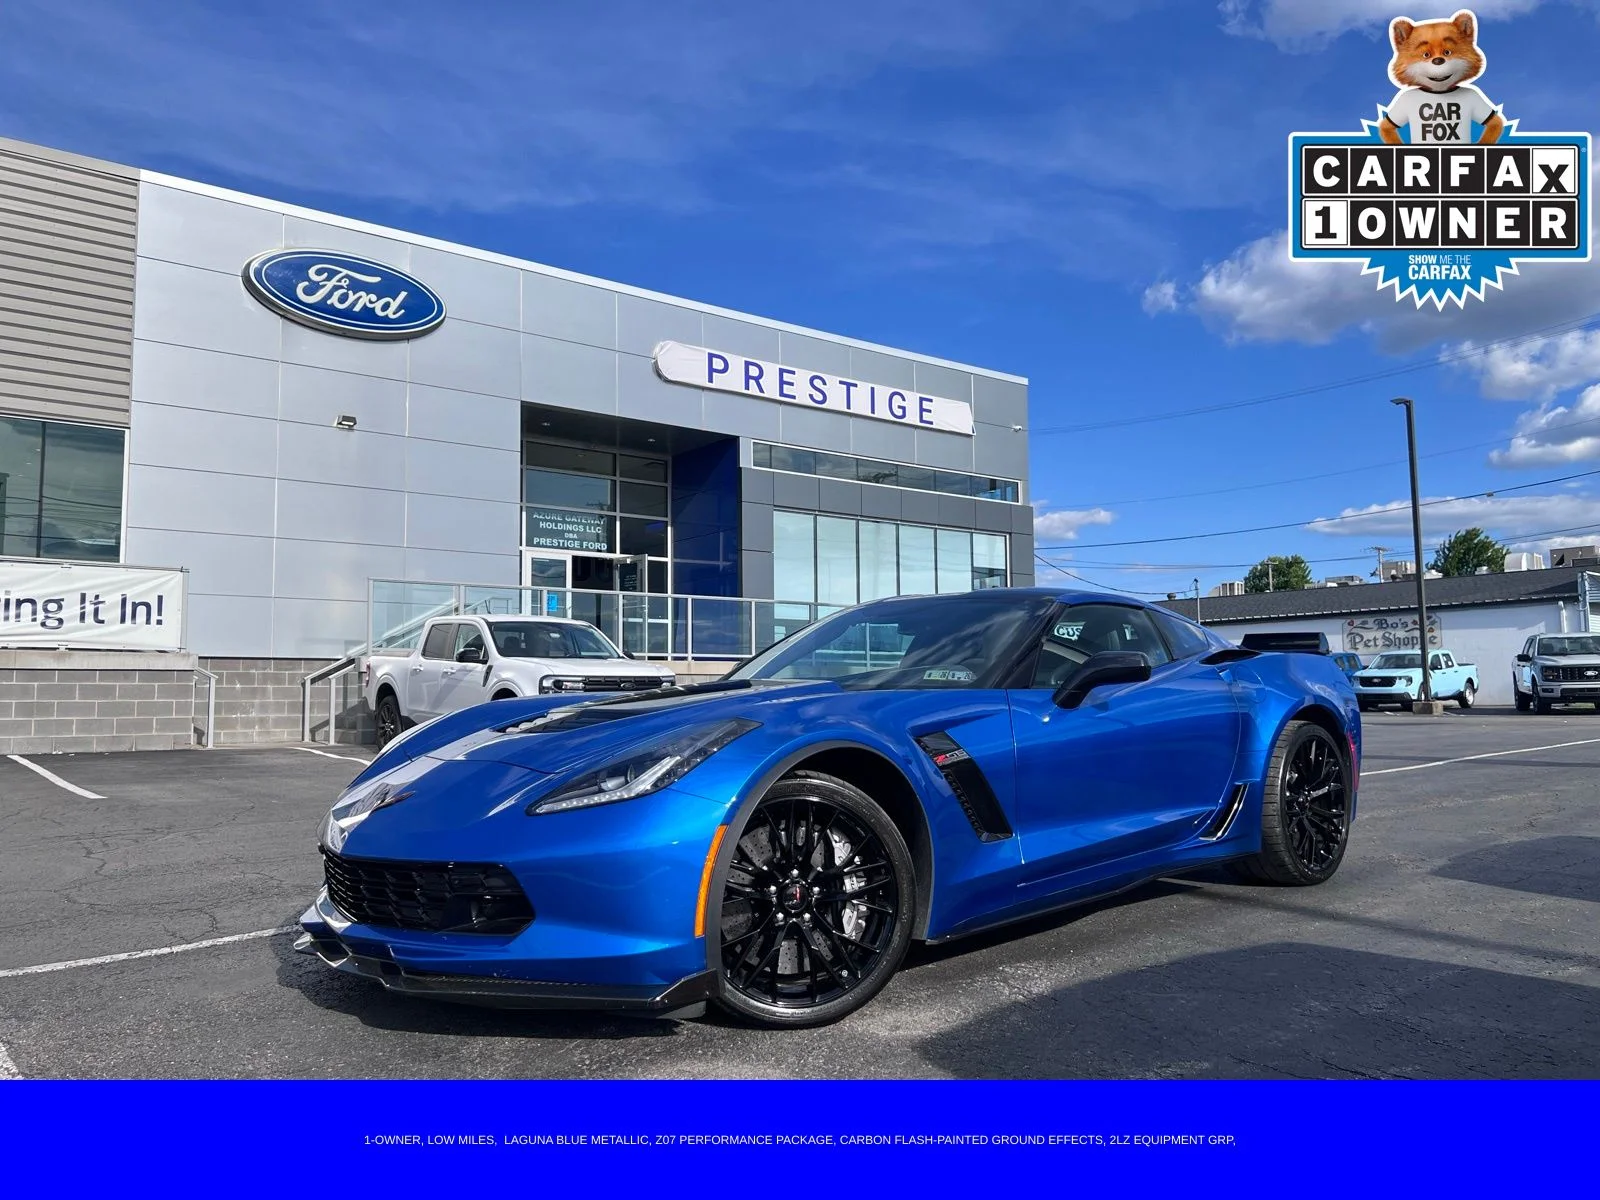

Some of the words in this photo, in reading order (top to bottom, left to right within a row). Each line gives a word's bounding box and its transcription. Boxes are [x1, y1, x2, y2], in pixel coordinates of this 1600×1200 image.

[295, 263, 408, 320] Ford
[706, 351, 934, 425] PRESTIGE
[533, 511, 563, 521] AZURE
[539, 521, 584, 532] HOLDINGS
[586, 525, 602, 534] LLC
[533, 537, 581, 548] PRESTIGE
[583, 541, 607, 551] FORD
[0, 590, 65, 630] ing
[79, 592, 106, 624] It
[120, 593, 164, 626] In!
[1373, 618, 1409, 631] Bo's
[1346, 632, 1379, 651] Pet
[1381, 631, 1438, 650] Shope
